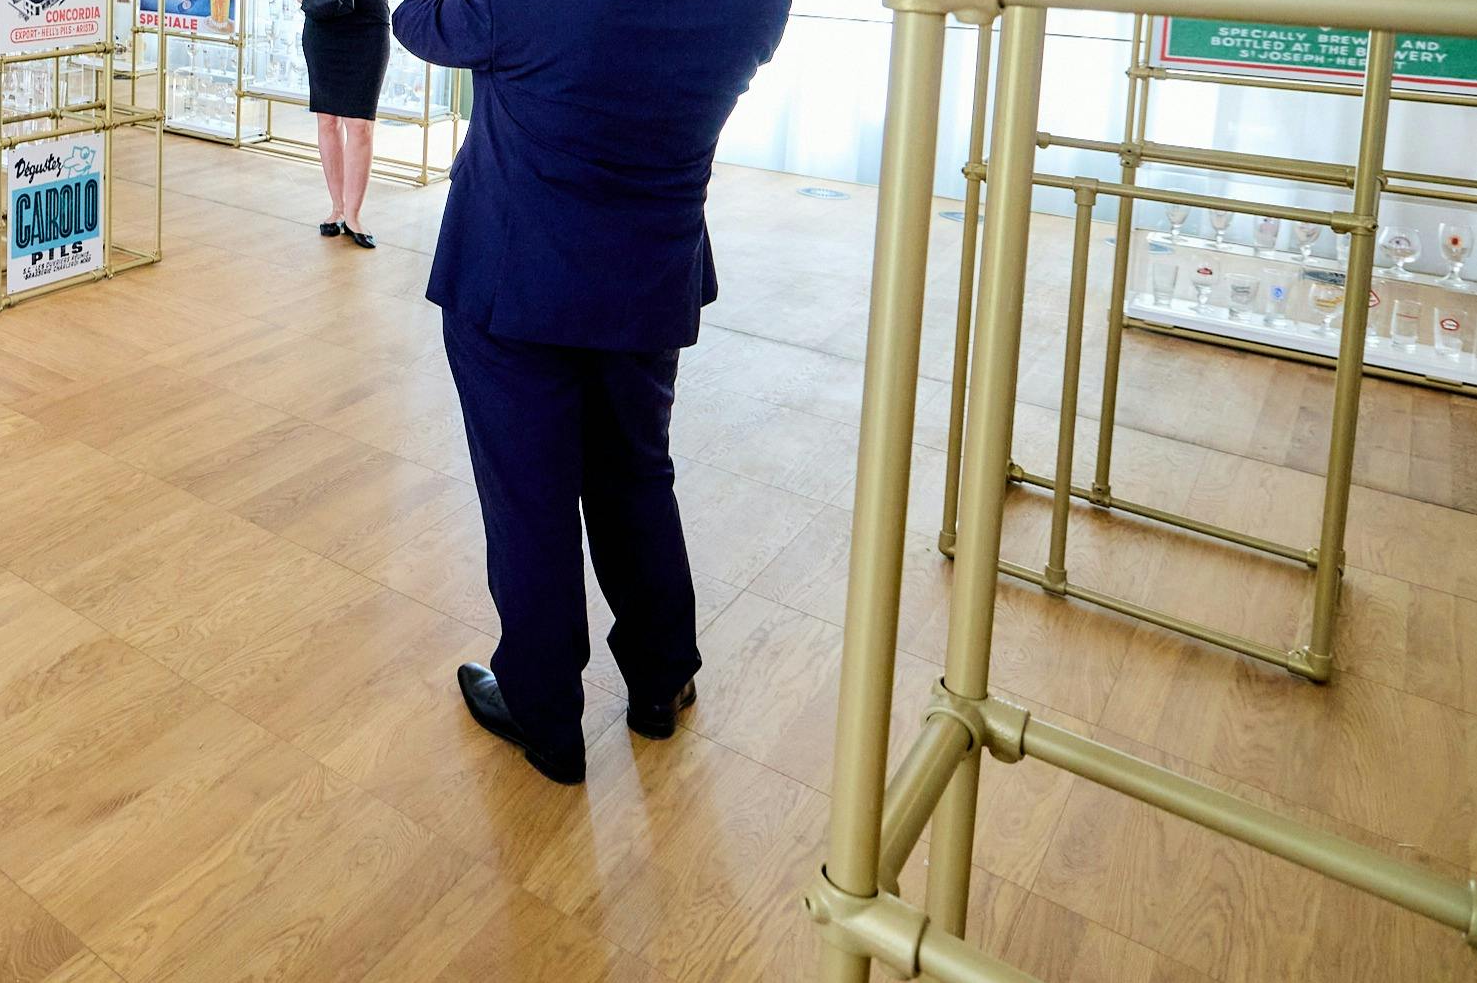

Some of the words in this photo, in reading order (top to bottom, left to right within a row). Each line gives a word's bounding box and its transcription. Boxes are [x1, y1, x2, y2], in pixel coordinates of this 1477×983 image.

[45, 6, 101, 23] CONCORDIA
[14, 30, 37, 41] EXPORT
[59, 26, 72, 36] PILS
[75, 24, 95, 34] ARISTA
[1218, 26, 1307, 42] SPECIALLY
[1317, 33, 1369, 45] BREW
[1401, 39, 1440, 52] AND
[1210, 36, 1284, 51] BOTTLED
[1292, 39, 1310, 52] AT
[1318, 44, 1348, 56] THE
[1355, 46, 1448, 65] BWERY
[1257, 50, 1325, 65] JOSEPH
[1336, 56, 1406, 70] HERT
[14, 152, 64, 184] Dégustez
[15, 179, 98, 249] CAROLO
[31, 240, 83, 265] PILS
